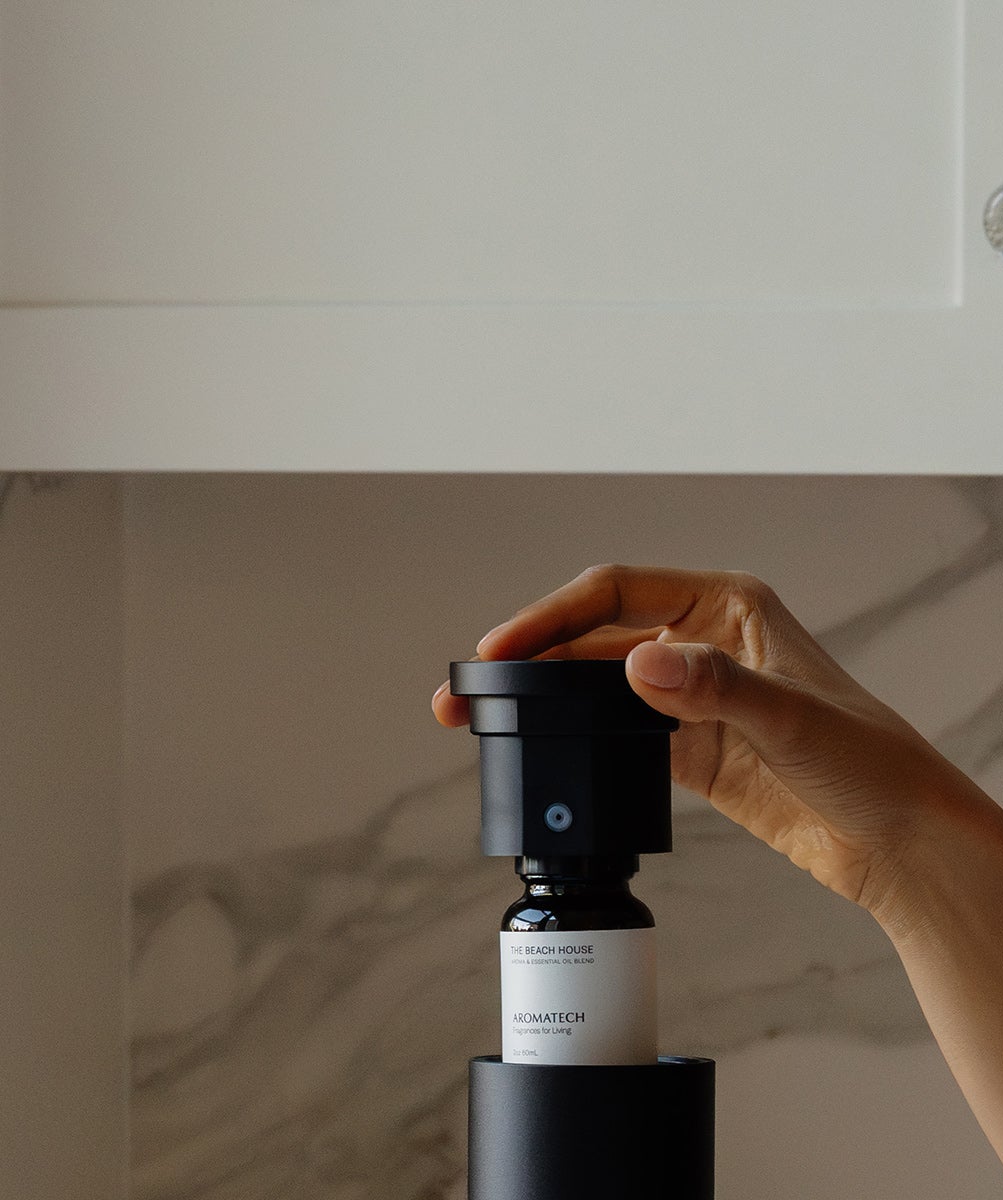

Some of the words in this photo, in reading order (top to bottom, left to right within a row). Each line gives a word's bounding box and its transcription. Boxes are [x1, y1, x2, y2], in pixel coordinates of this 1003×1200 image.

[511, 946, 523, 955] THE
[525, 946, 555, 955] BEACH
[558, 945, 594, 954] HOUSE
[513, 1012, 585, 1023] AROMATECH
[552, 1026, 572, 1035] Living
